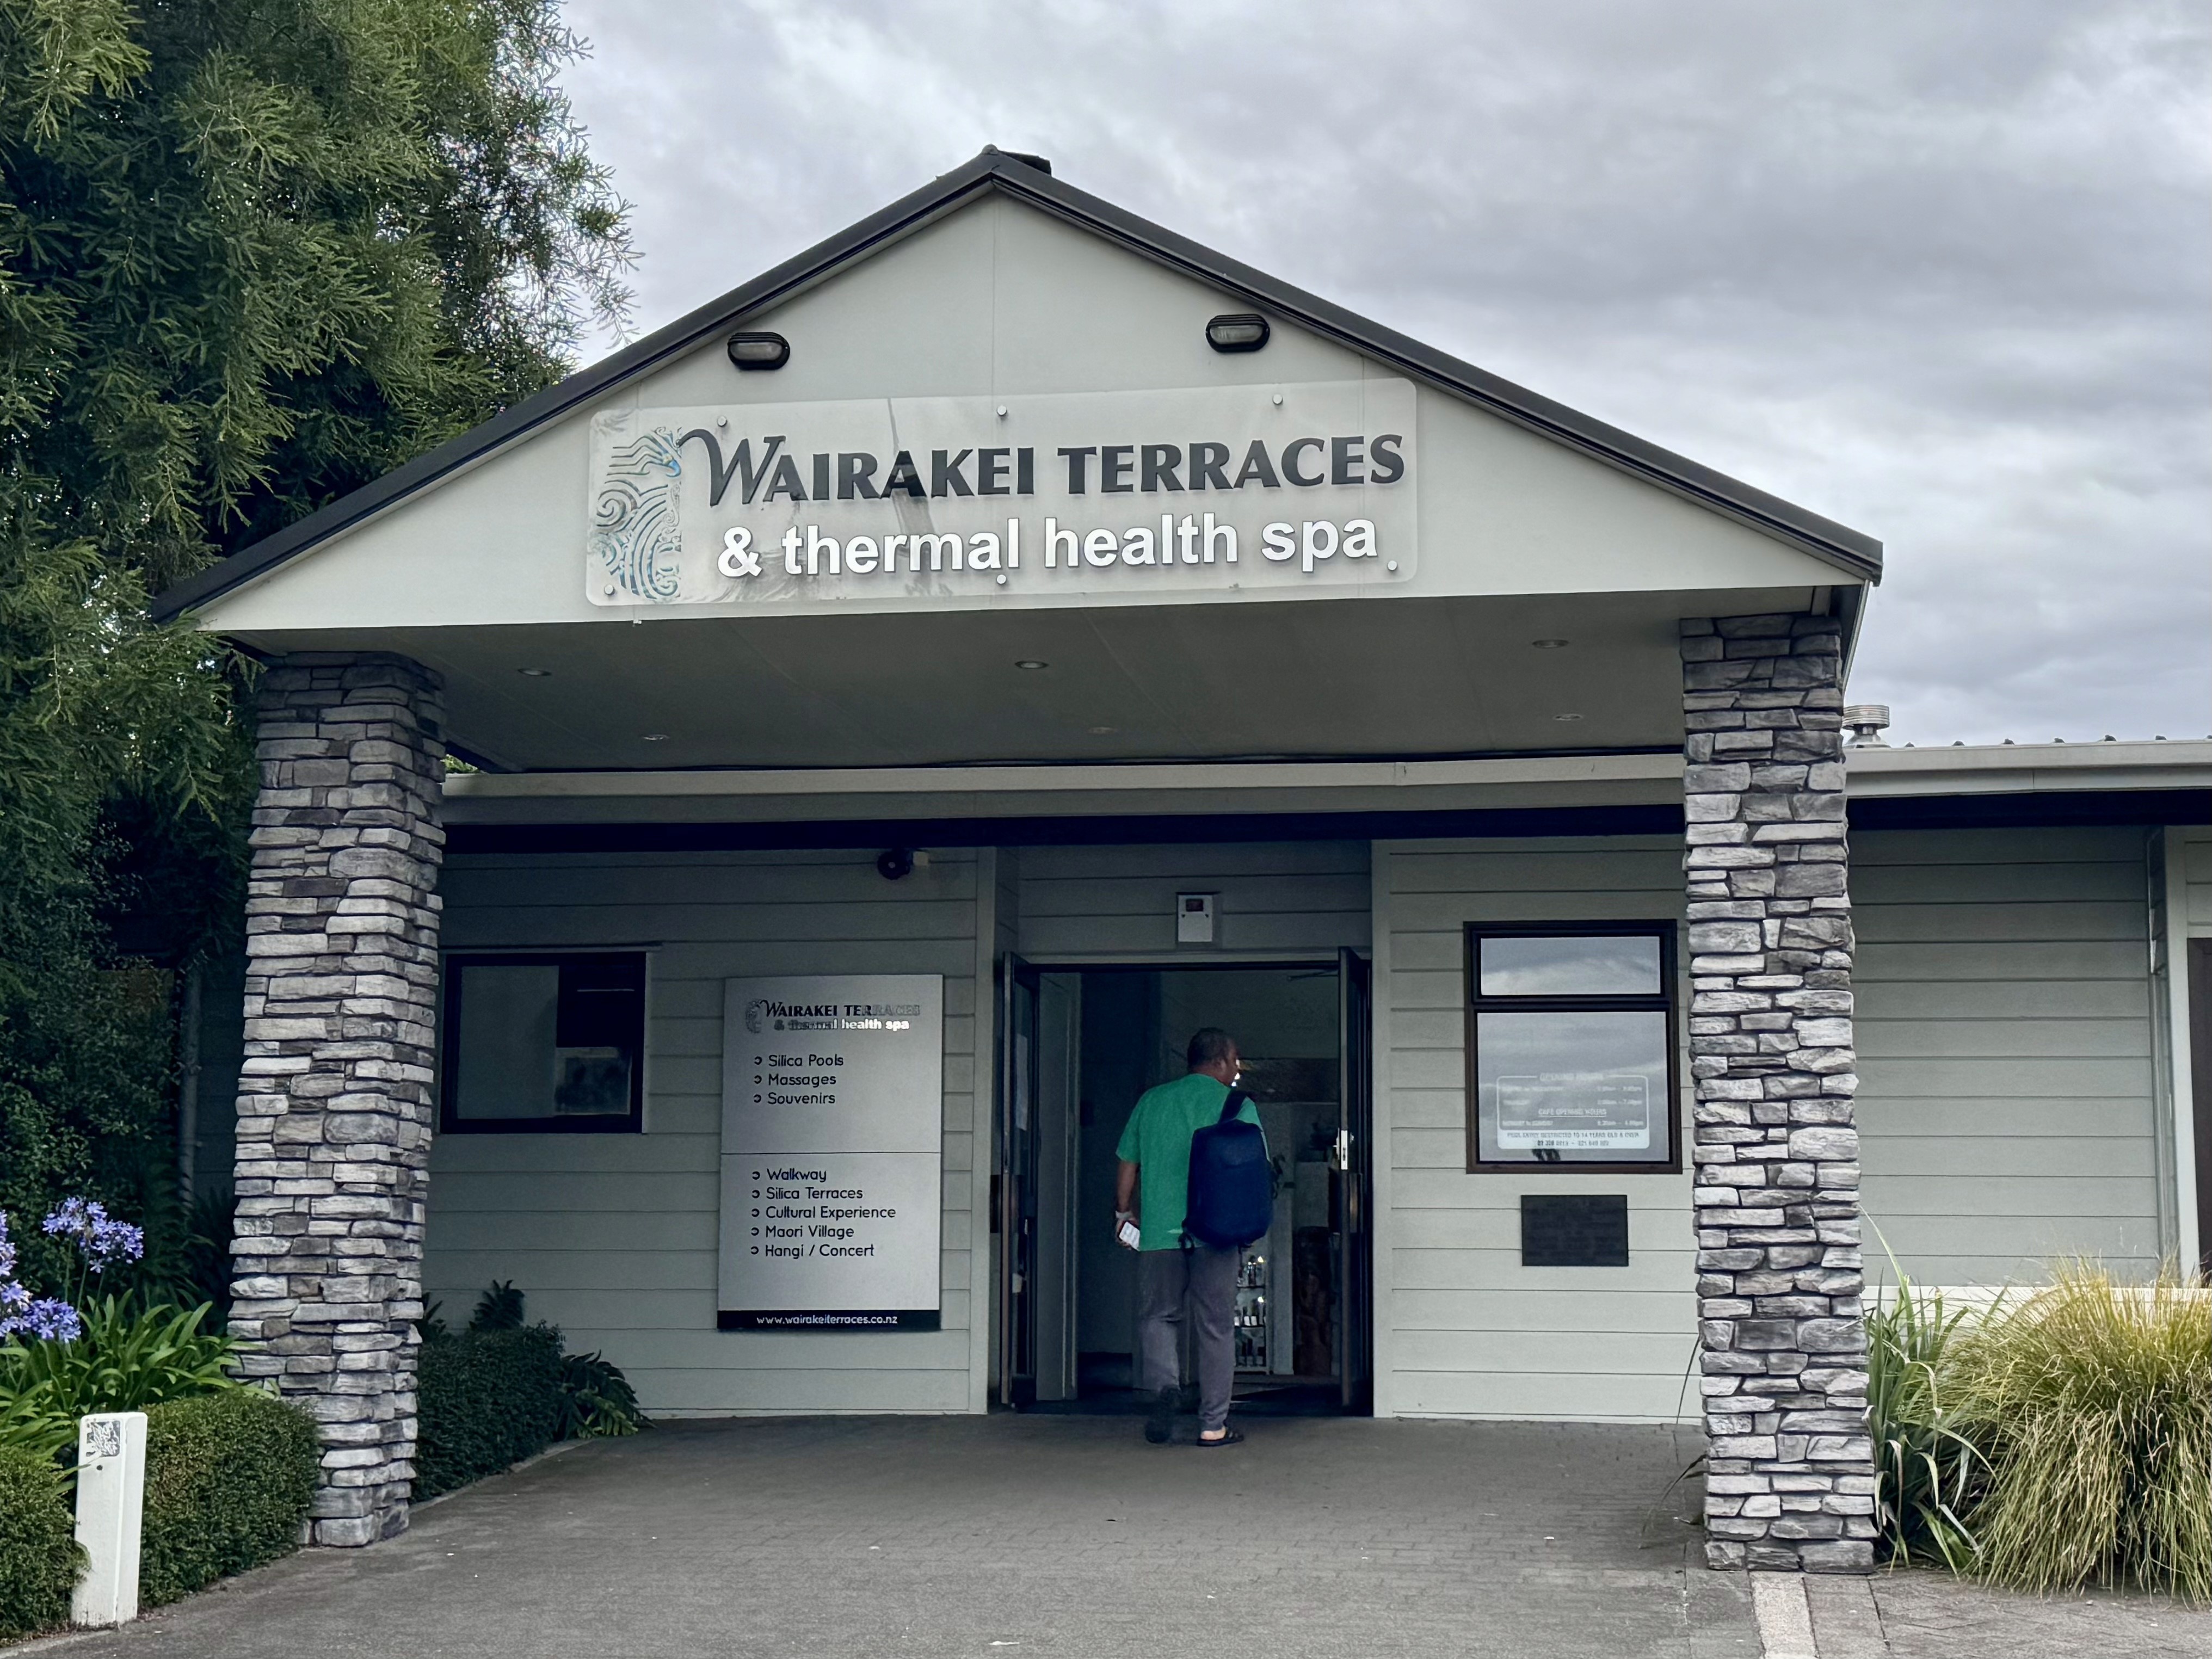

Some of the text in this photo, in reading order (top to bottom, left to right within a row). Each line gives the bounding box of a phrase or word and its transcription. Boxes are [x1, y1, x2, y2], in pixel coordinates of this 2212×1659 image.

[676, 427, 1405, 507] WAIRAKEI TERRACES
[717, 513, 1378, 578] & thermal health spa
[760, 1000, 837, 1017] WAIRAKEI
[841, 1019, 882, 1029] health
[885, 1019, 909, 1032] spa
[768, 1054, 844, 1066] Silica Pools
[768, 1074, 836, 1088] Massages
[768, 1092, 835, 1105] Souvenirs
[767, 1168, 827, 1182] Walkway
[766, 1187, 863, 1200] Silica Terraces
[766, 1206, 896, 1221] Cultural Experience
[766, 1225, 854, 1239] Maori Village
[765, 1243, 874, 1260] Hangi / Concert
[756, 1315, 898, 1324] www.wairakeiterraces.co.nz
